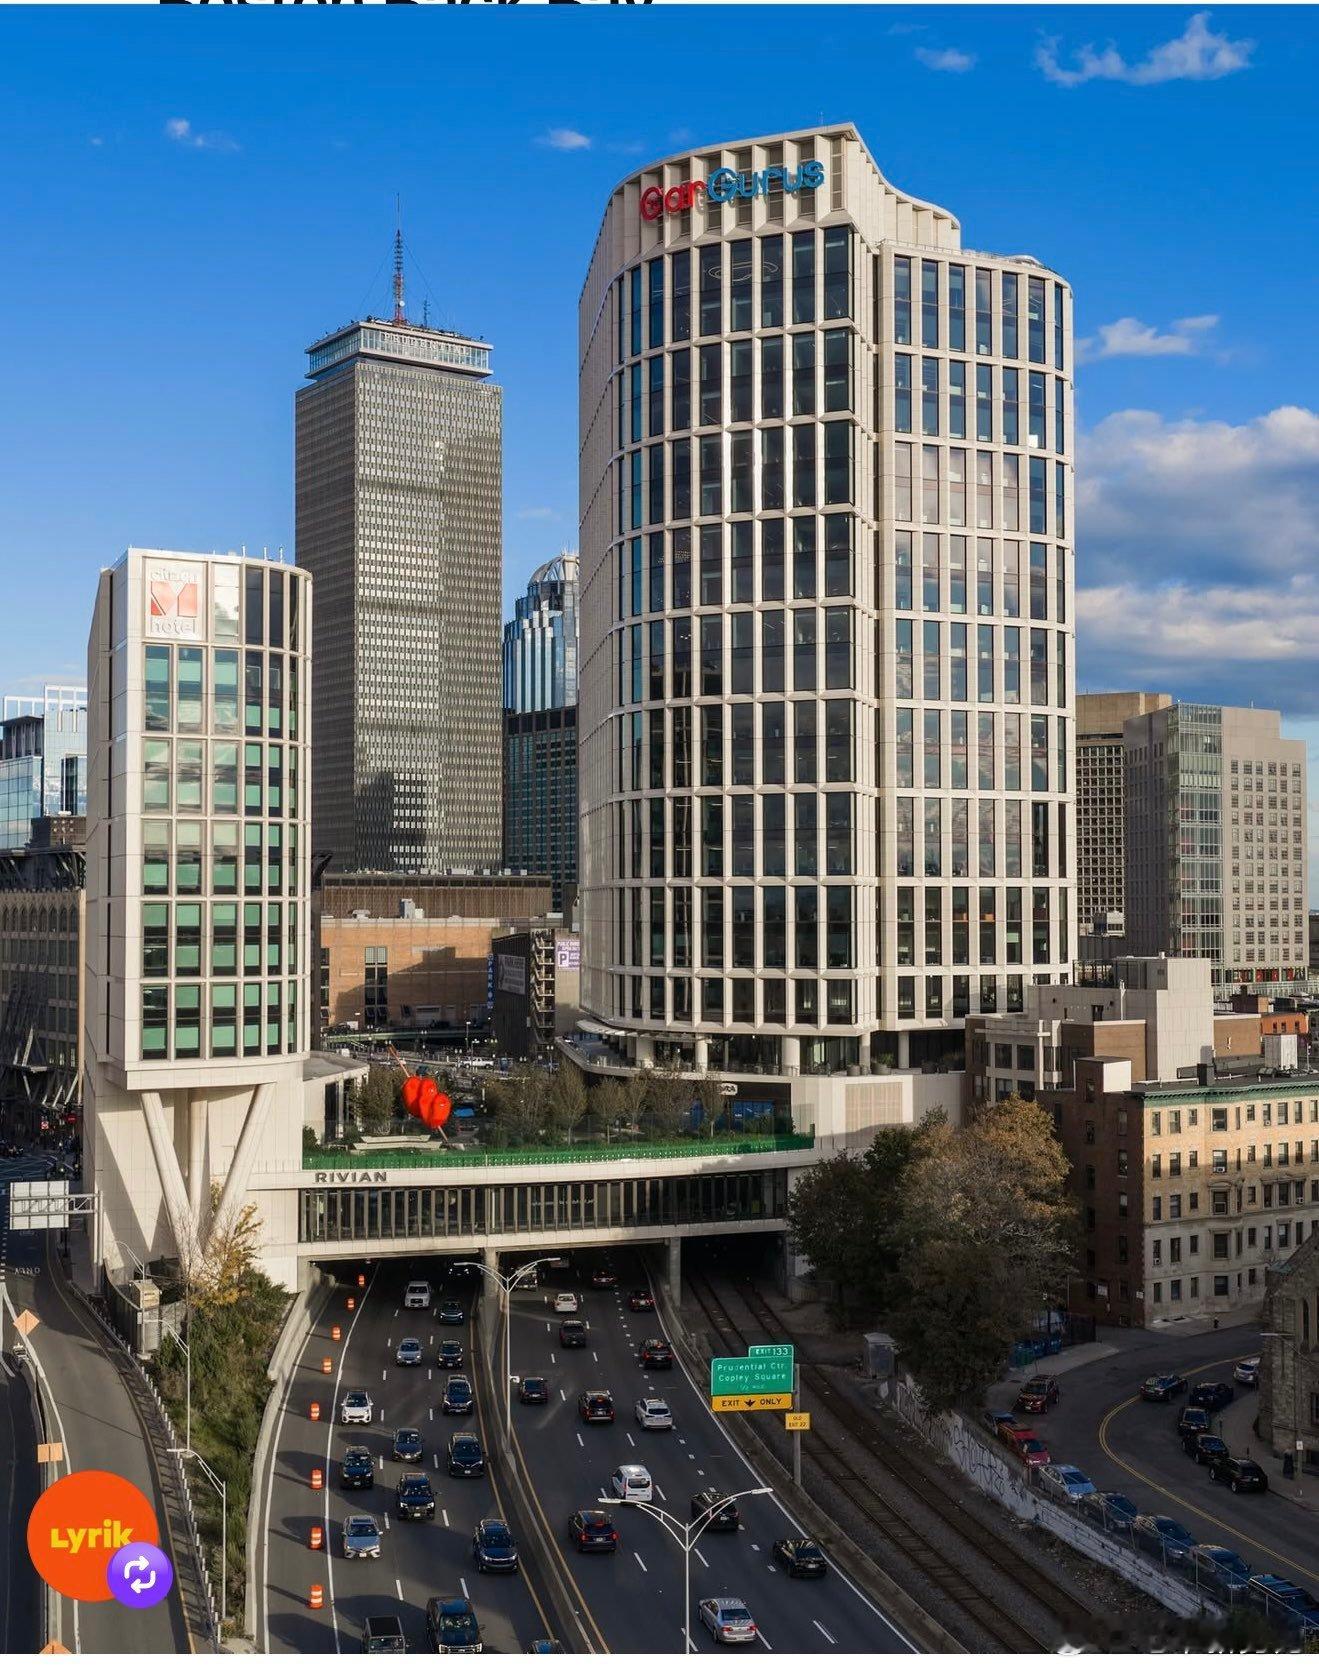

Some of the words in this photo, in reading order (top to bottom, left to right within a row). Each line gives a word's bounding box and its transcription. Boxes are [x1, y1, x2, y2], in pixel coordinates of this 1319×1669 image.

[640, 159, 825, 221] CarGurus
[151, 617, 196, 635] hotel
[314, 1171, 387, 1183] RIVIAN
[773, 1347, 788, 1355] 133
[718, 1374, 749, 1383] Copley
[754, 1373, 786, 1381] Square
